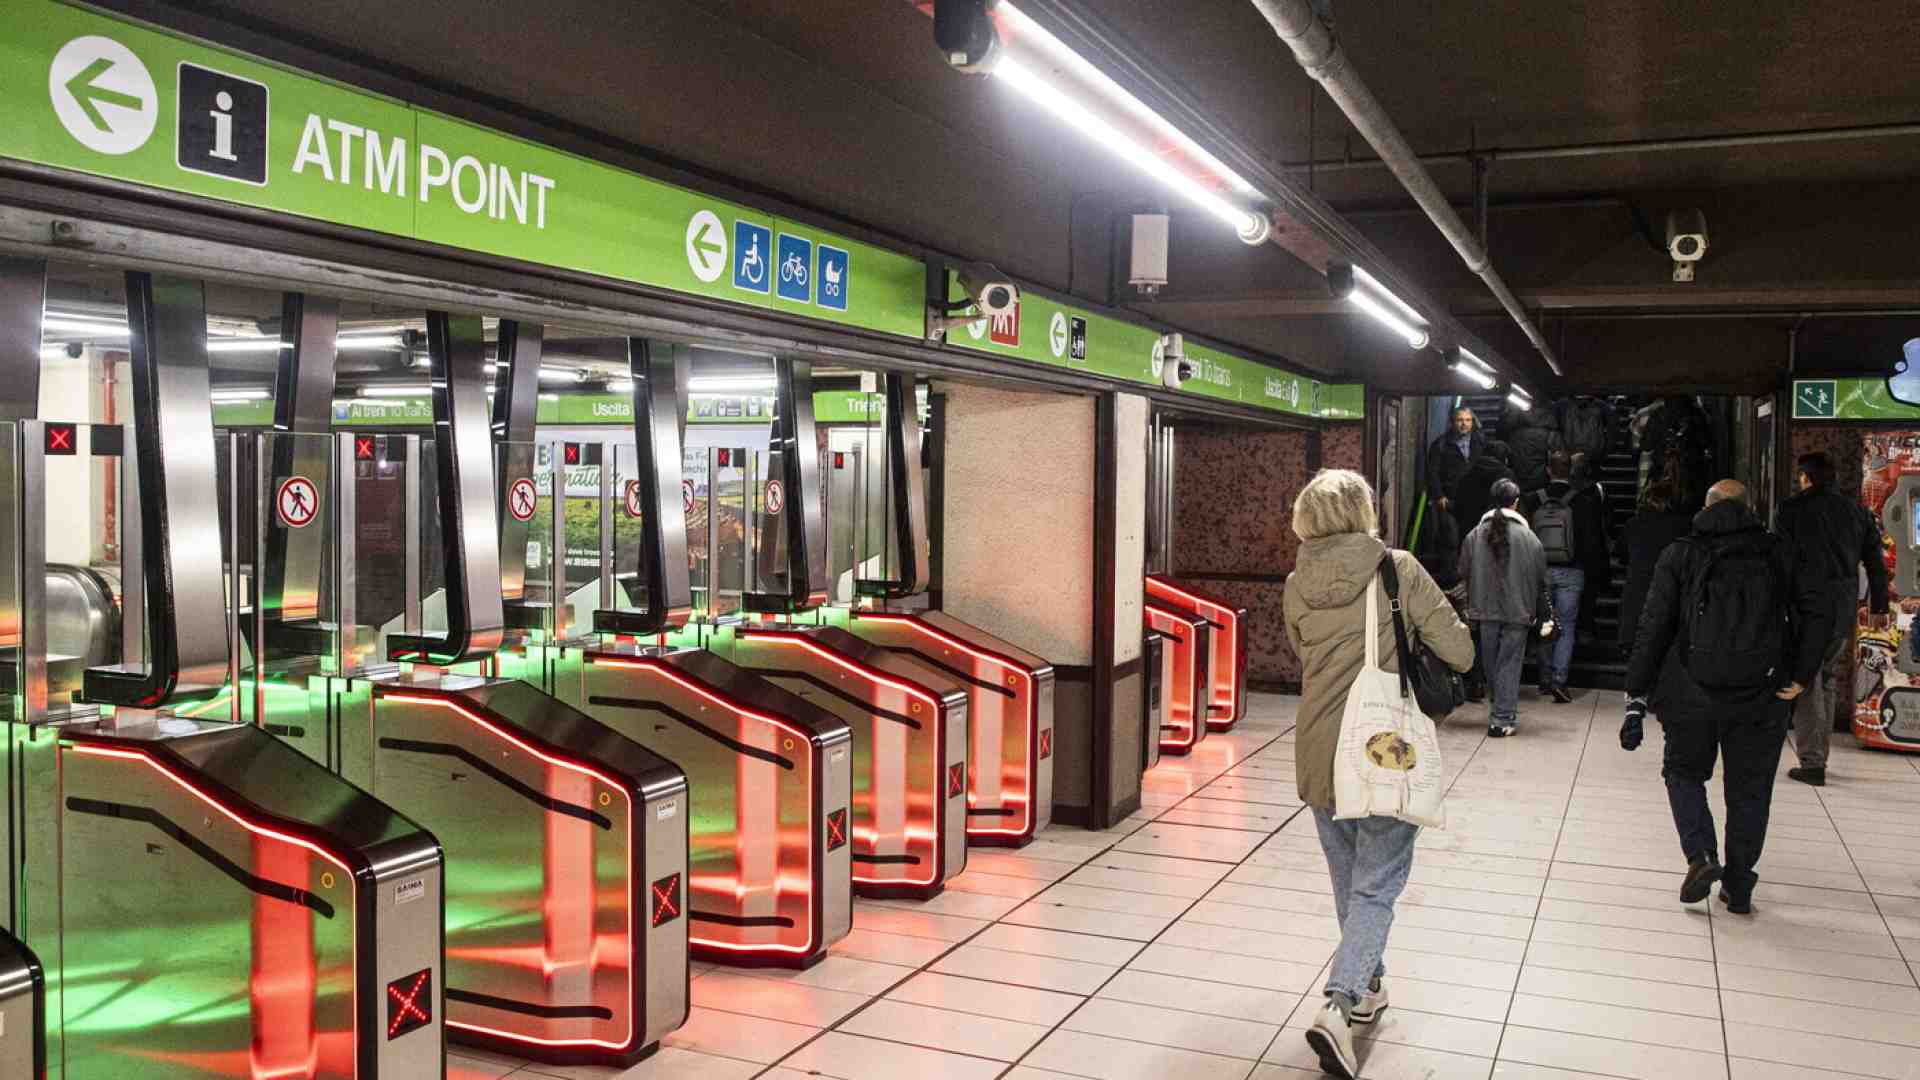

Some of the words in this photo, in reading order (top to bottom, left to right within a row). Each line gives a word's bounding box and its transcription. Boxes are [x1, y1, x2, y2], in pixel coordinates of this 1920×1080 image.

[292, 113, 406, 197] ATM
[420, 144, 555, 229] POINT
[592, 402, 631, 416] Uscita
